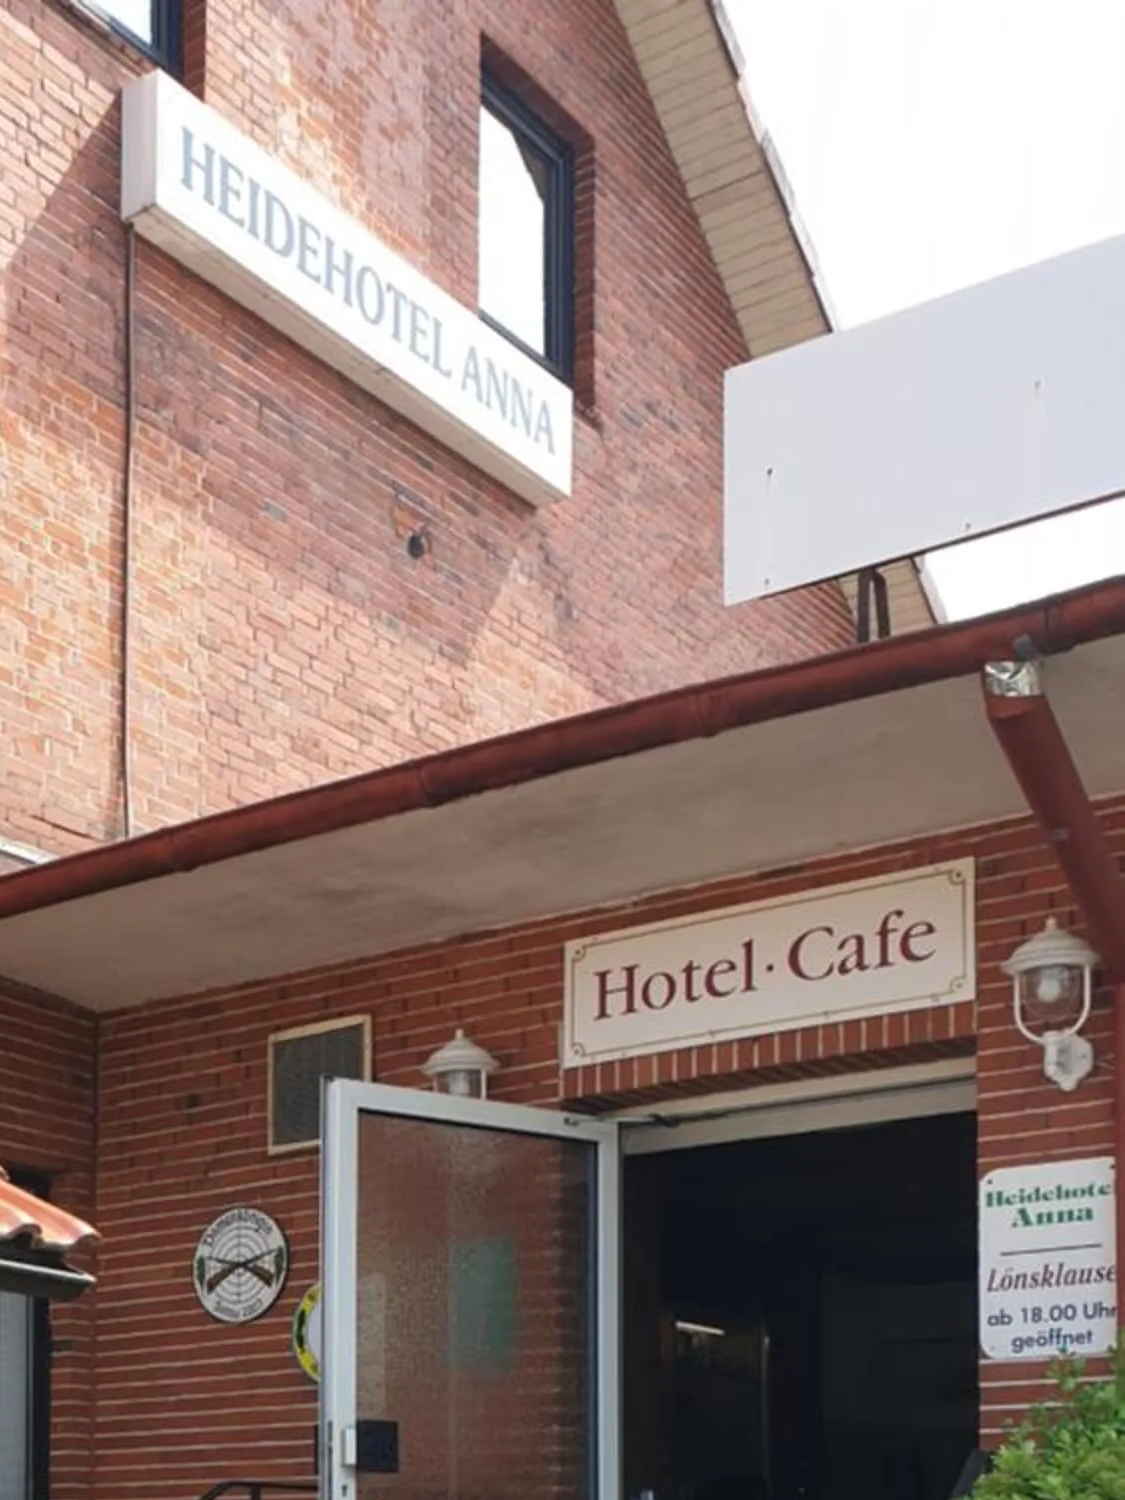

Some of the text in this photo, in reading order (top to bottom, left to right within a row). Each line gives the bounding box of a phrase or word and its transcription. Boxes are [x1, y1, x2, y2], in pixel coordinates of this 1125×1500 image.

[180, 125, 556, 456] HEIDEHOTEL ANNA
[592, 939, 761, 1021] Hotel
[786, 909, 938, 982] Cafe
[986, 1182, 1112, 1208] Heidehote
[1012, 1206, 1094, 1228] Anna
[986, 1262, 1116, 1293] Lönsklause
[987, 1308, 1013, 1327] ab
[1021, 1304, 1077, 1324] 18.00
[1011, 1328, 1093, 1354] geöffnet
